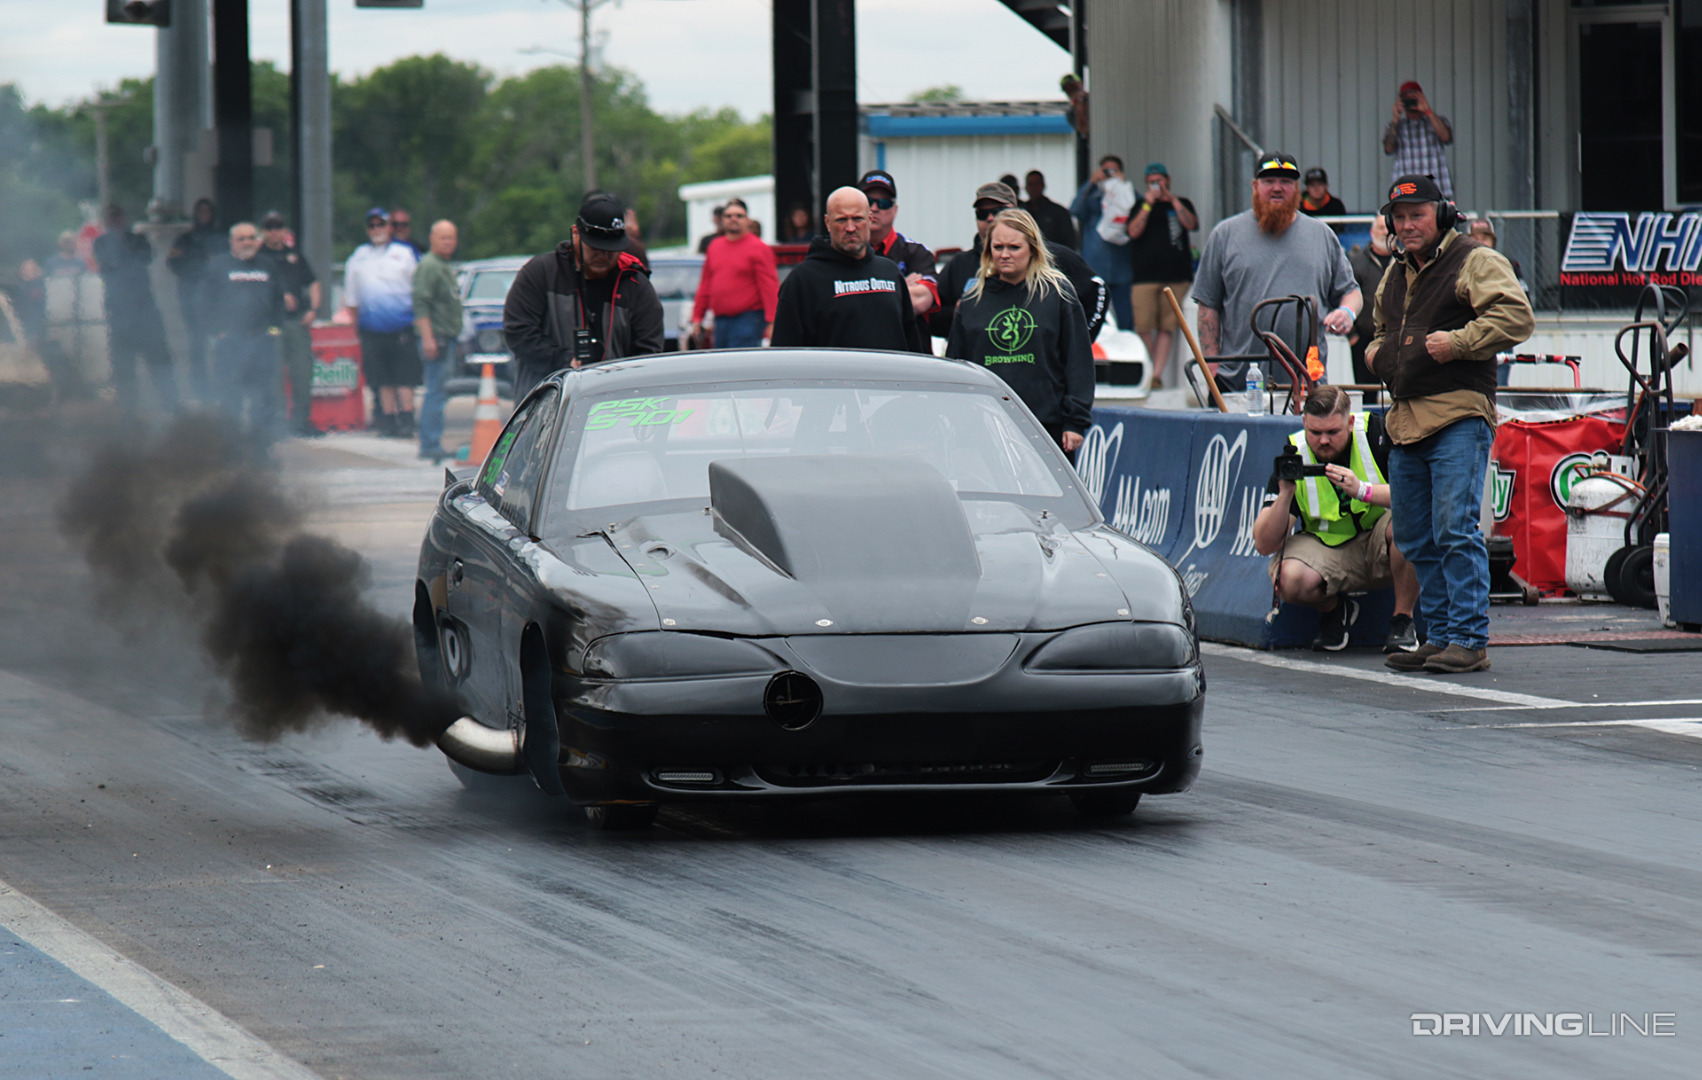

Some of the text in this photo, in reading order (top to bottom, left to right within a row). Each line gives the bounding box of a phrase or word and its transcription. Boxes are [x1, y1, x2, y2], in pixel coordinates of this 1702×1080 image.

[870, 277, 896, 292] OUTLET
[1560, 272, 1619, 286] National
[1623, 272, 1646, 286] Hot
[1651, 272, 1677, 286] Rod
[1112, 474, 1171, 545] AAA.com
